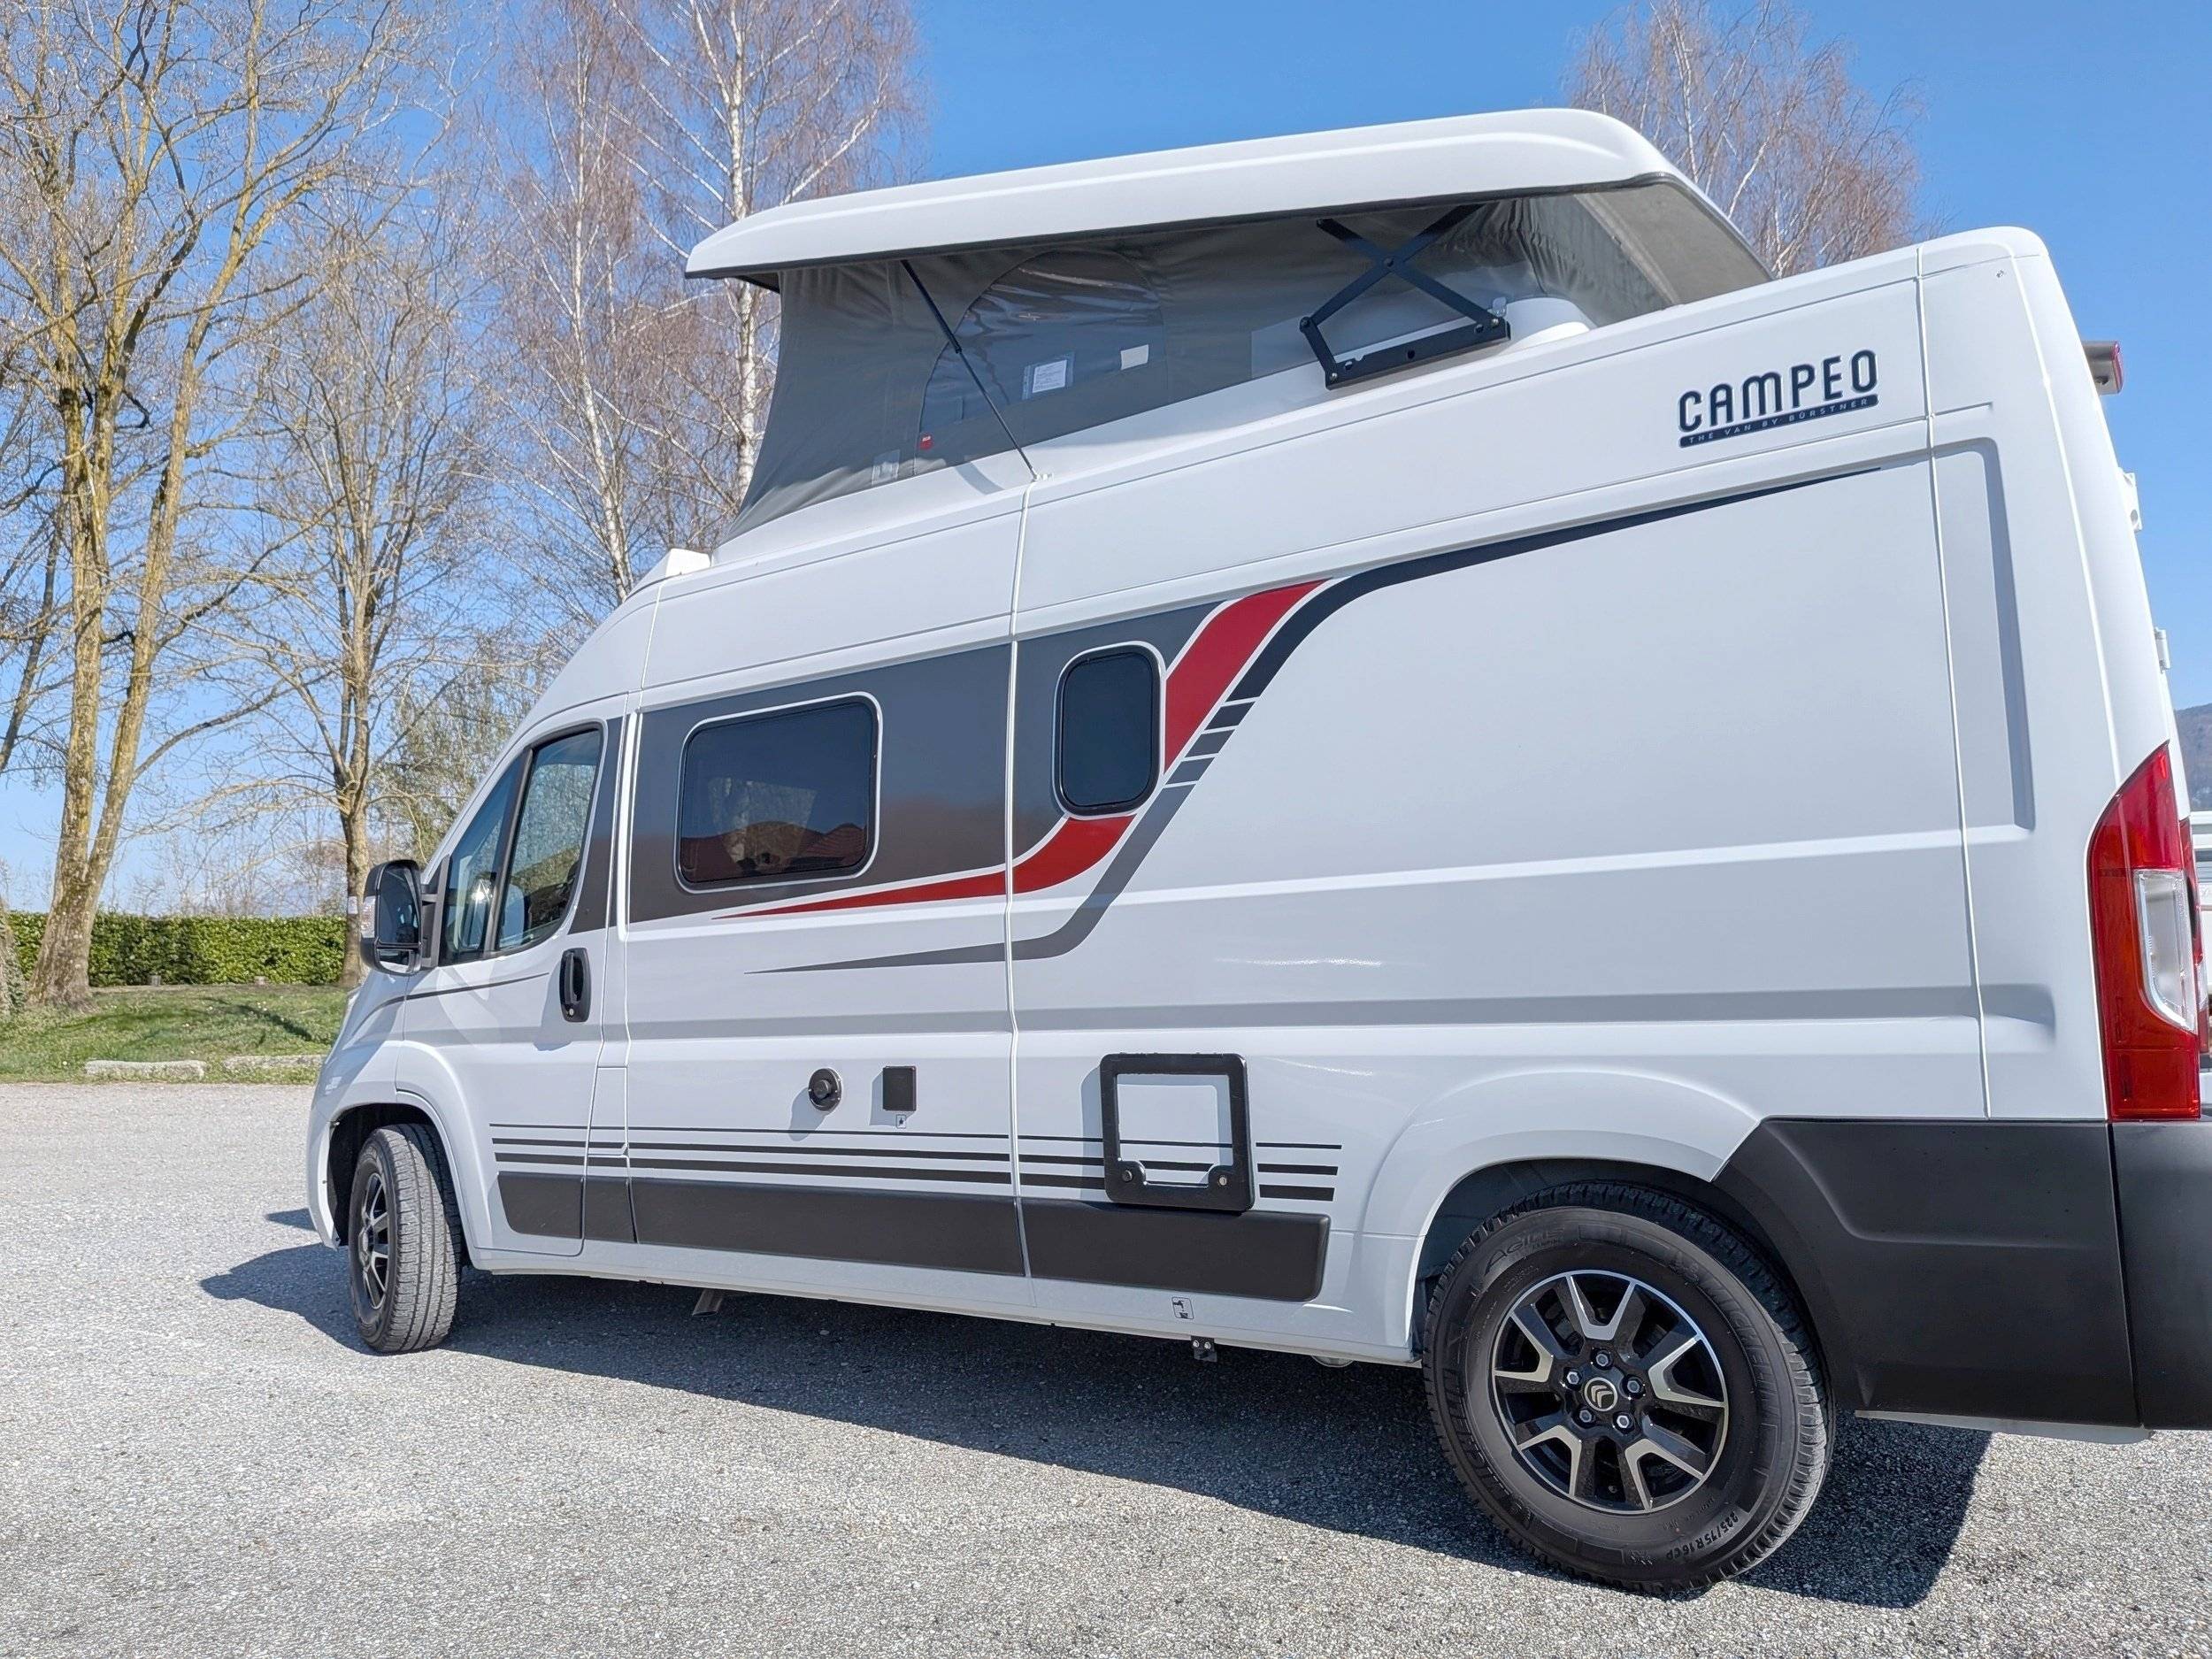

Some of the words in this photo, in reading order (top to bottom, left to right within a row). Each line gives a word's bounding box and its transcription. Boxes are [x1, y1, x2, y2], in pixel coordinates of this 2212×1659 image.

[1678, 349, 1877, 432] CAMPEO
[1689, 433, 1714, 443] THE
[1724, 425, 1751, 435] VAN
[1762, 419, 1778, 427] BY
